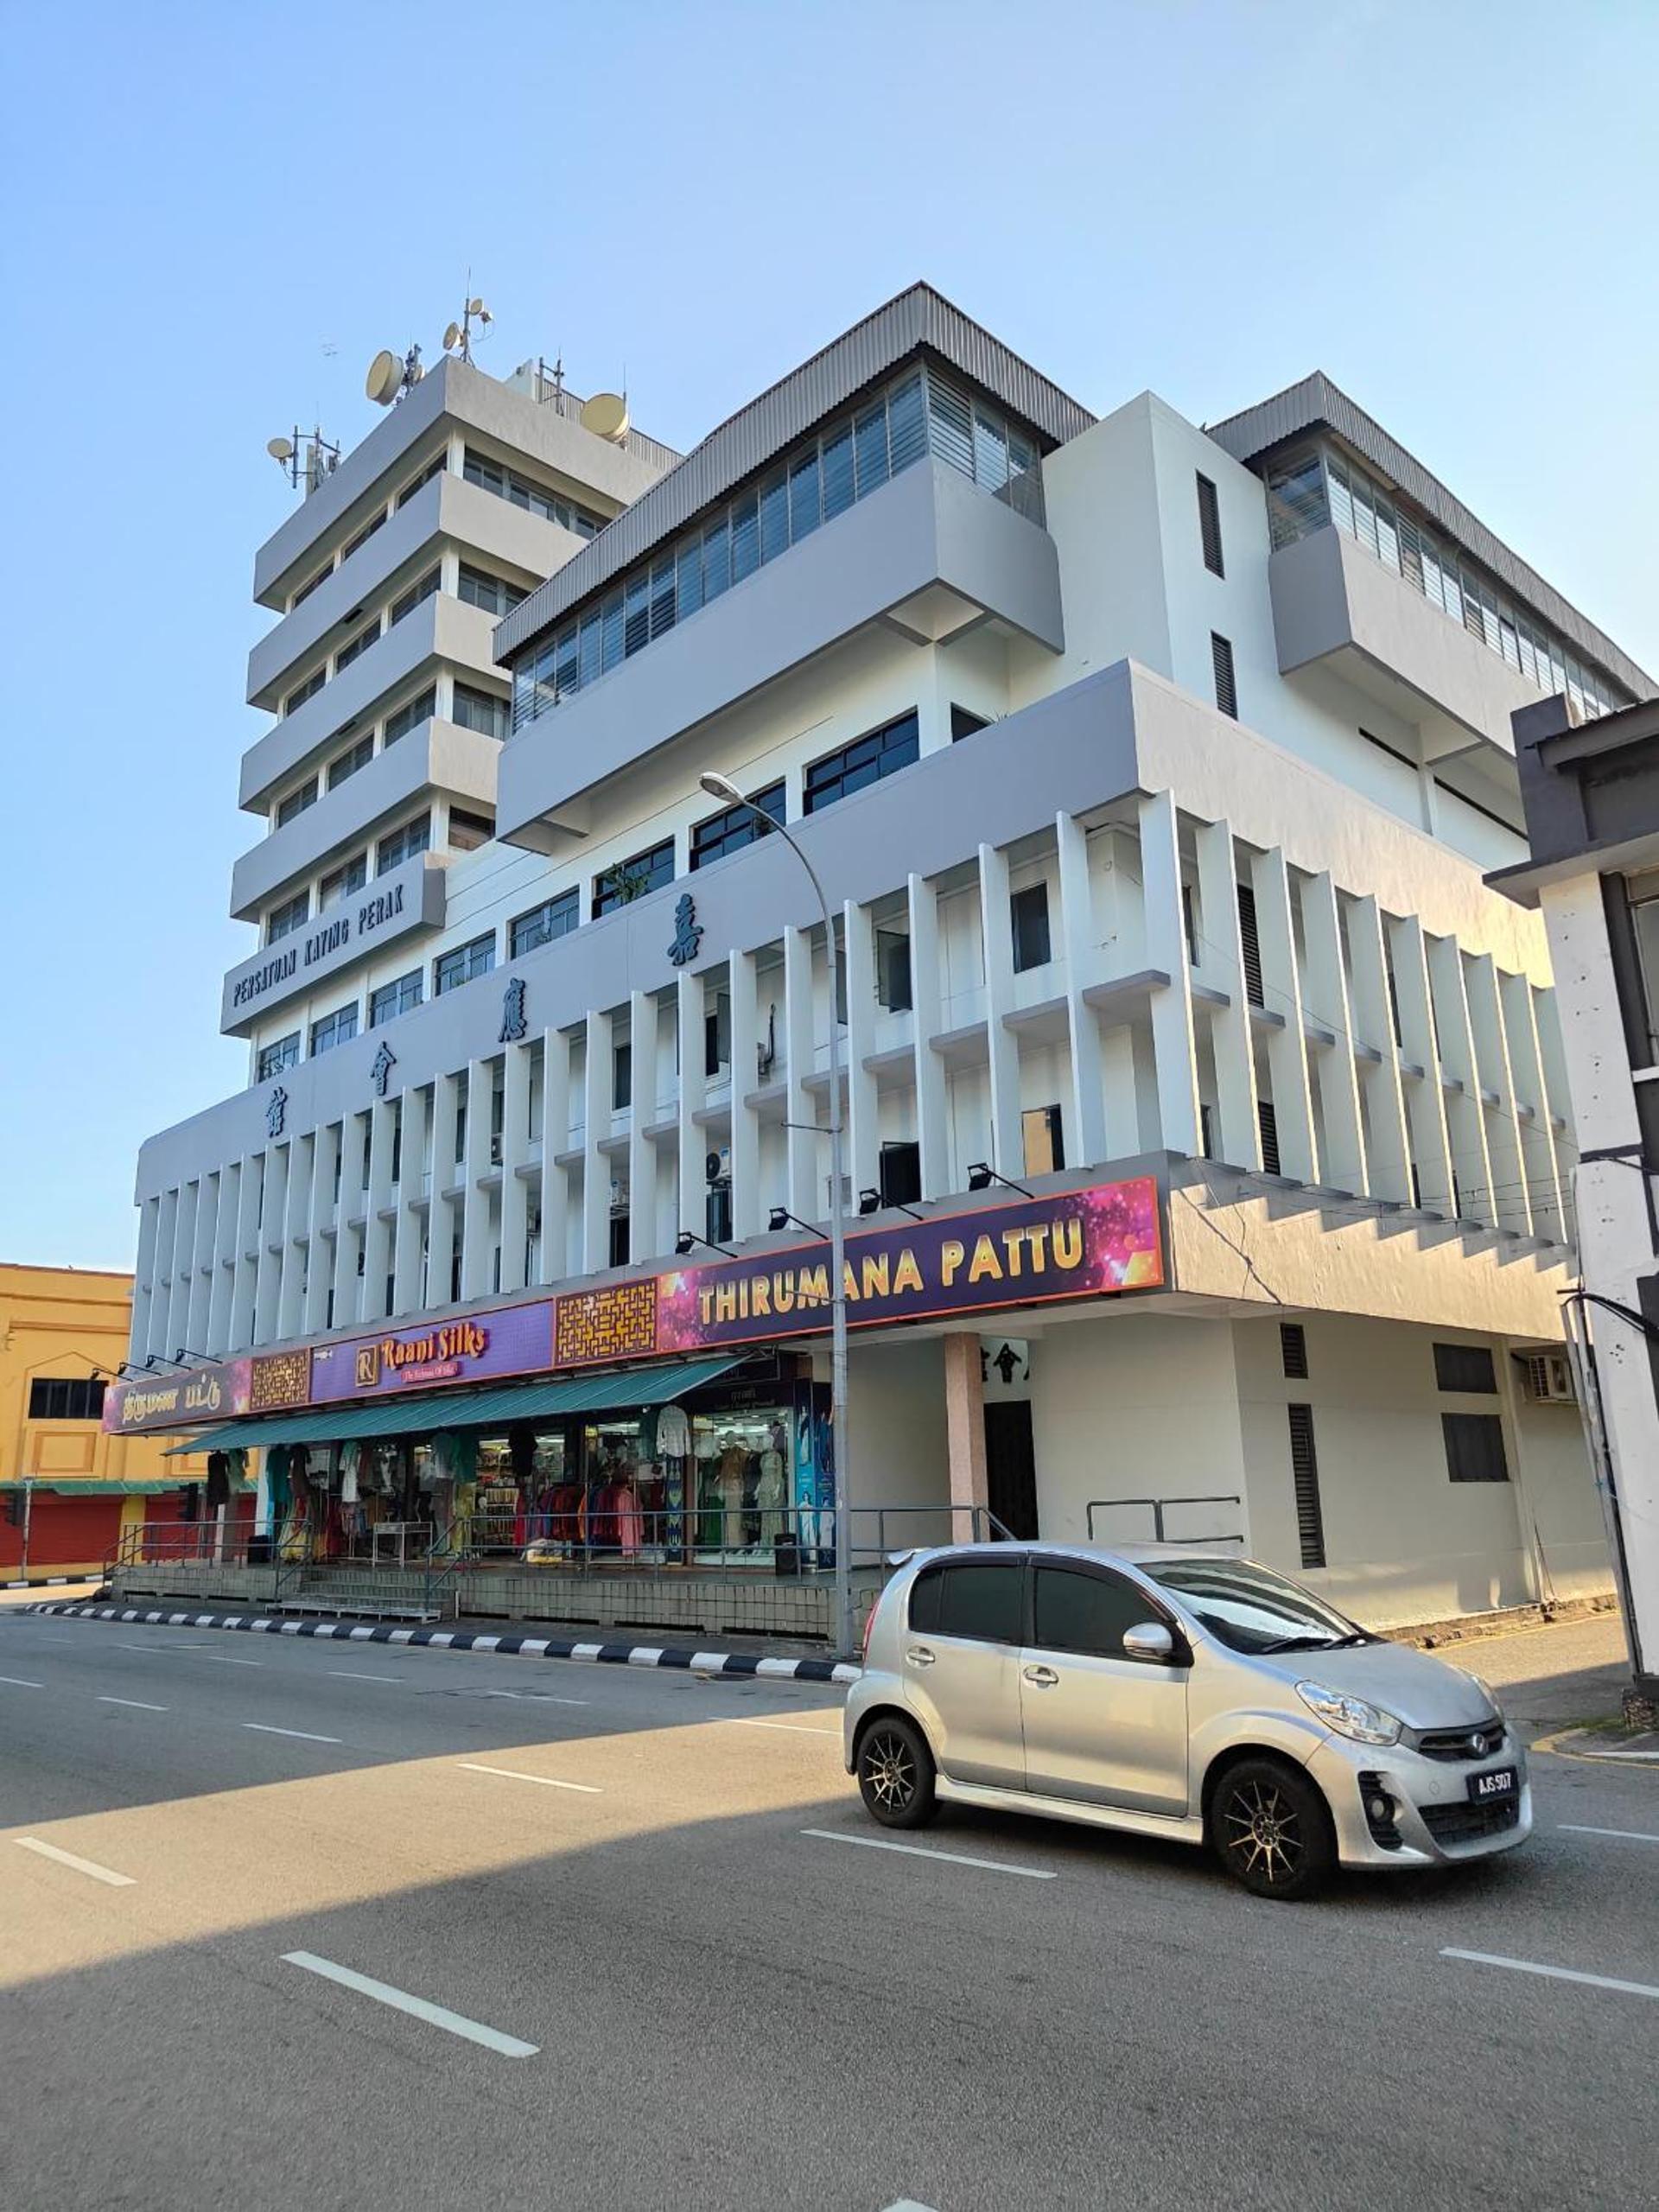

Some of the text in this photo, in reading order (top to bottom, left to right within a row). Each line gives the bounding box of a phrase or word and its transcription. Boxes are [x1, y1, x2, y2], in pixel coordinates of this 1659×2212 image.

[234, 884, 404, 1007] PERSATUAN KAYING PERAK
[698, 1218, 1082, 1325] THIRUMANA PATTU
[381, 1322, 486, 1370] Raani Silks
